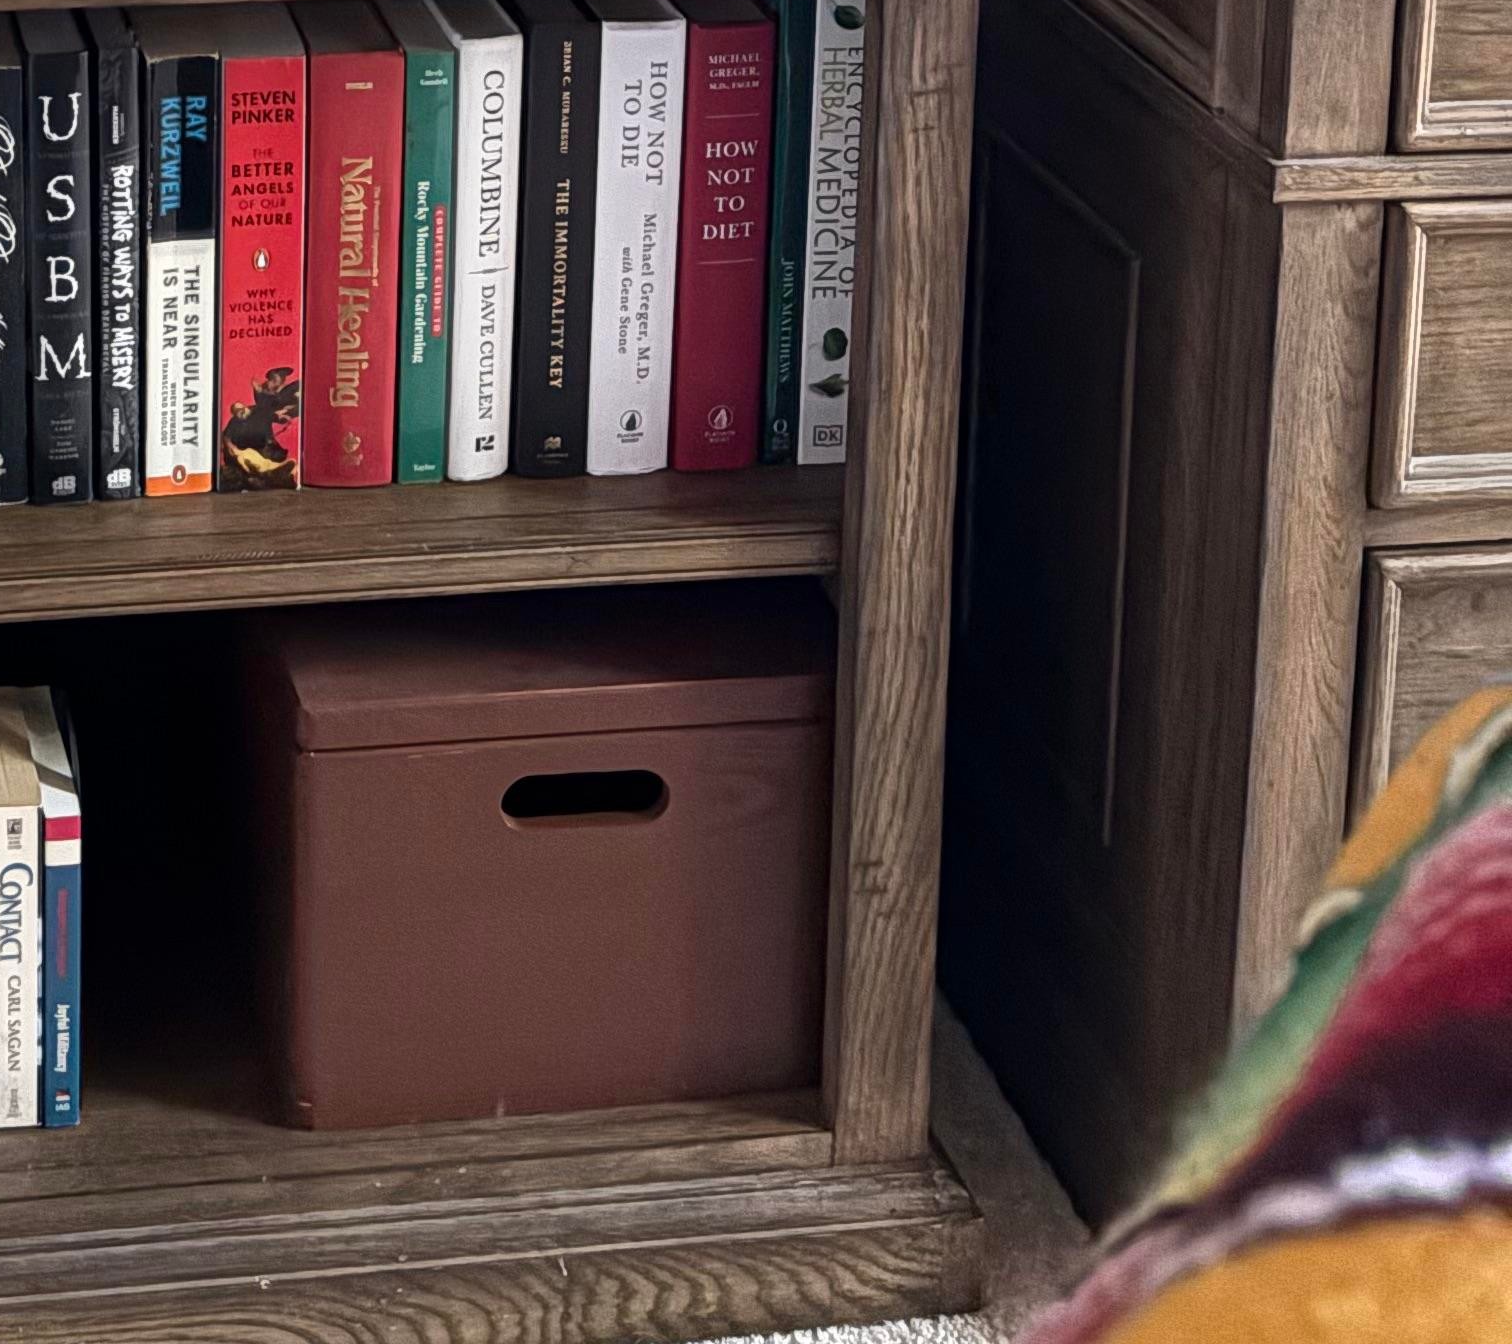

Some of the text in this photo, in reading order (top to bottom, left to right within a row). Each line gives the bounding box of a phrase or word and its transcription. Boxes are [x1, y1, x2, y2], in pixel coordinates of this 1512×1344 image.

[231, 91, 296, 106] STEVEN
[186, 95, 205, 141] RAY
[231, 108, 295, 123] PINKER
[160, 96, 181, 216] KURZWEIL
[705, 140, 758, 158] HOW
[479, 70, 505, 257] COLUMBINE
[707, 168, 753, 185] NOT
[812, 47, 847, 299] HERBAL MEDICINE
[714, 195, 745, 212] TO
[703, 221, 753, 240] DIET
[330, 156, 373, 407] Natural Healing
[162, 269, 178, 350] IS NEAR
[230, 301, 293, 313] VIOLENCE
[230, 326, 292, 339] DECLINED
[181, 266, 200, 446] THE SINGULARITY
[817, 430, 839, 444] DK
